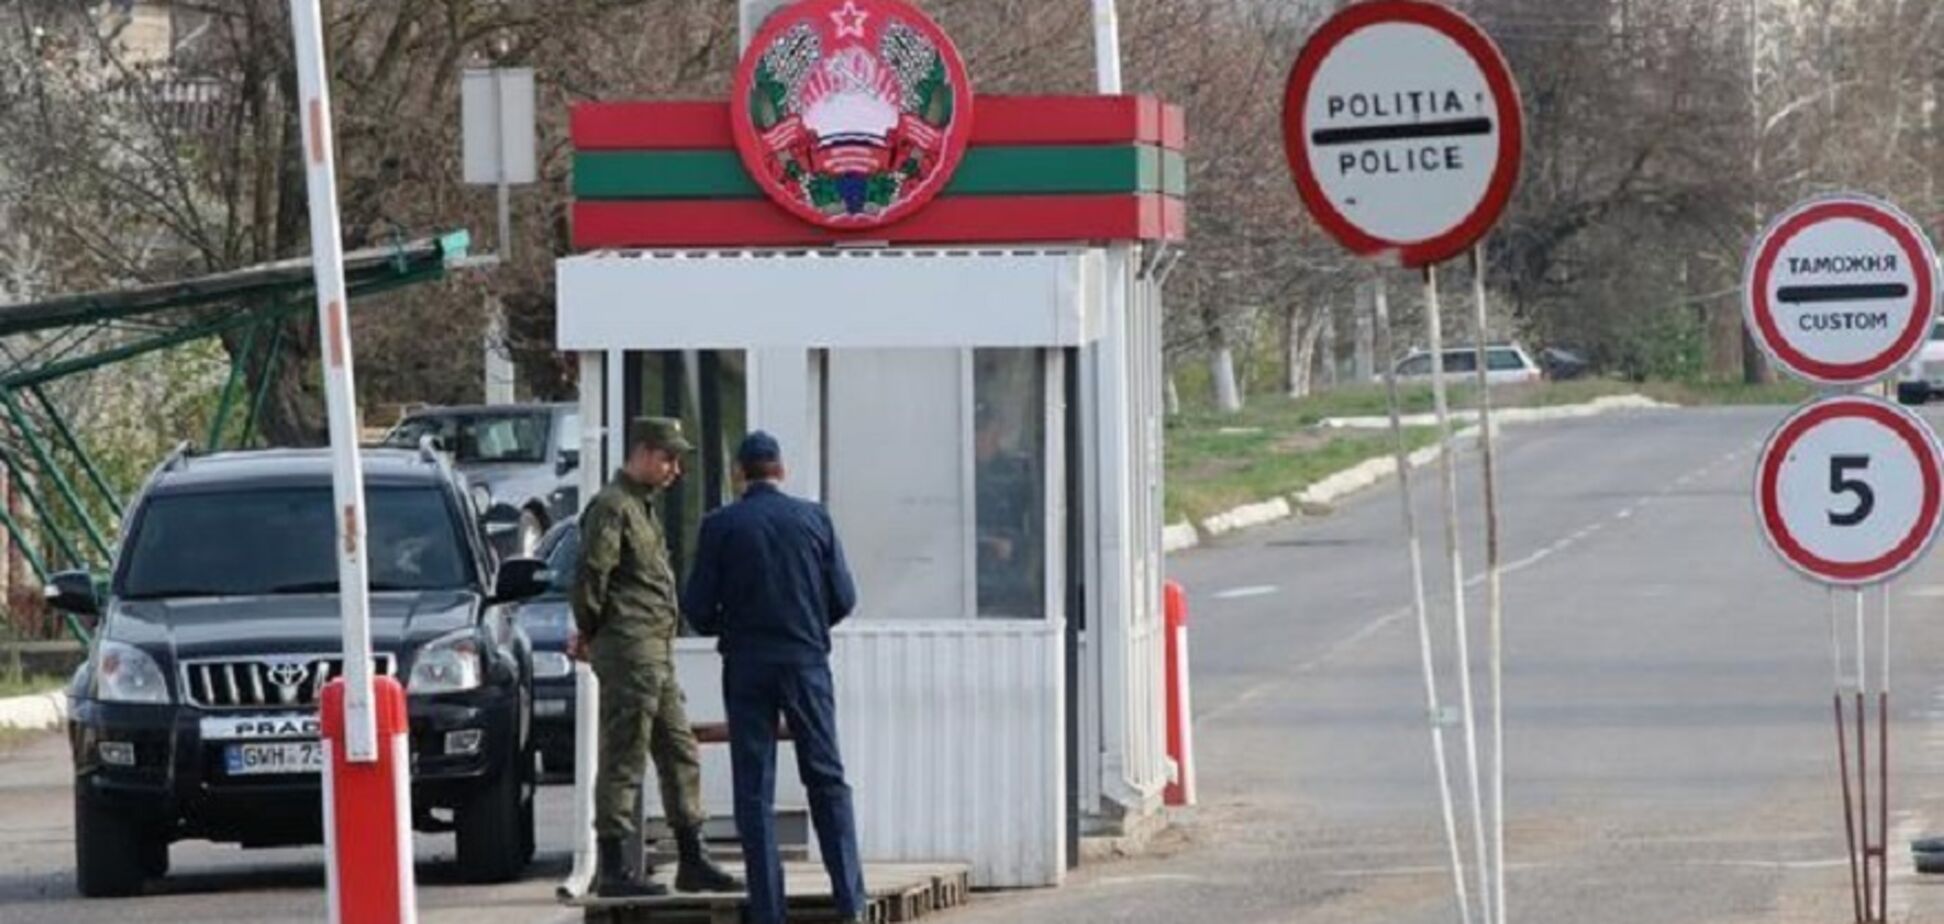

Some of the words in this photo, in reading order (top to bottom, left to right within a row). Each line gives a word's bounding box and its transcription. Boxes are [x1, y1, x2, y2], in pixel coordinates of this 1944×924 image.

[1328, 90, 1463, 118] POLITIA
[1339, 146, 1463, 175] POLICE
[1789, 254, 1898, 274] ТАМОЖНЯ
[1798, 312, 1888, 330] CUSTOM
[1827, 454, 1875, 527] 5
